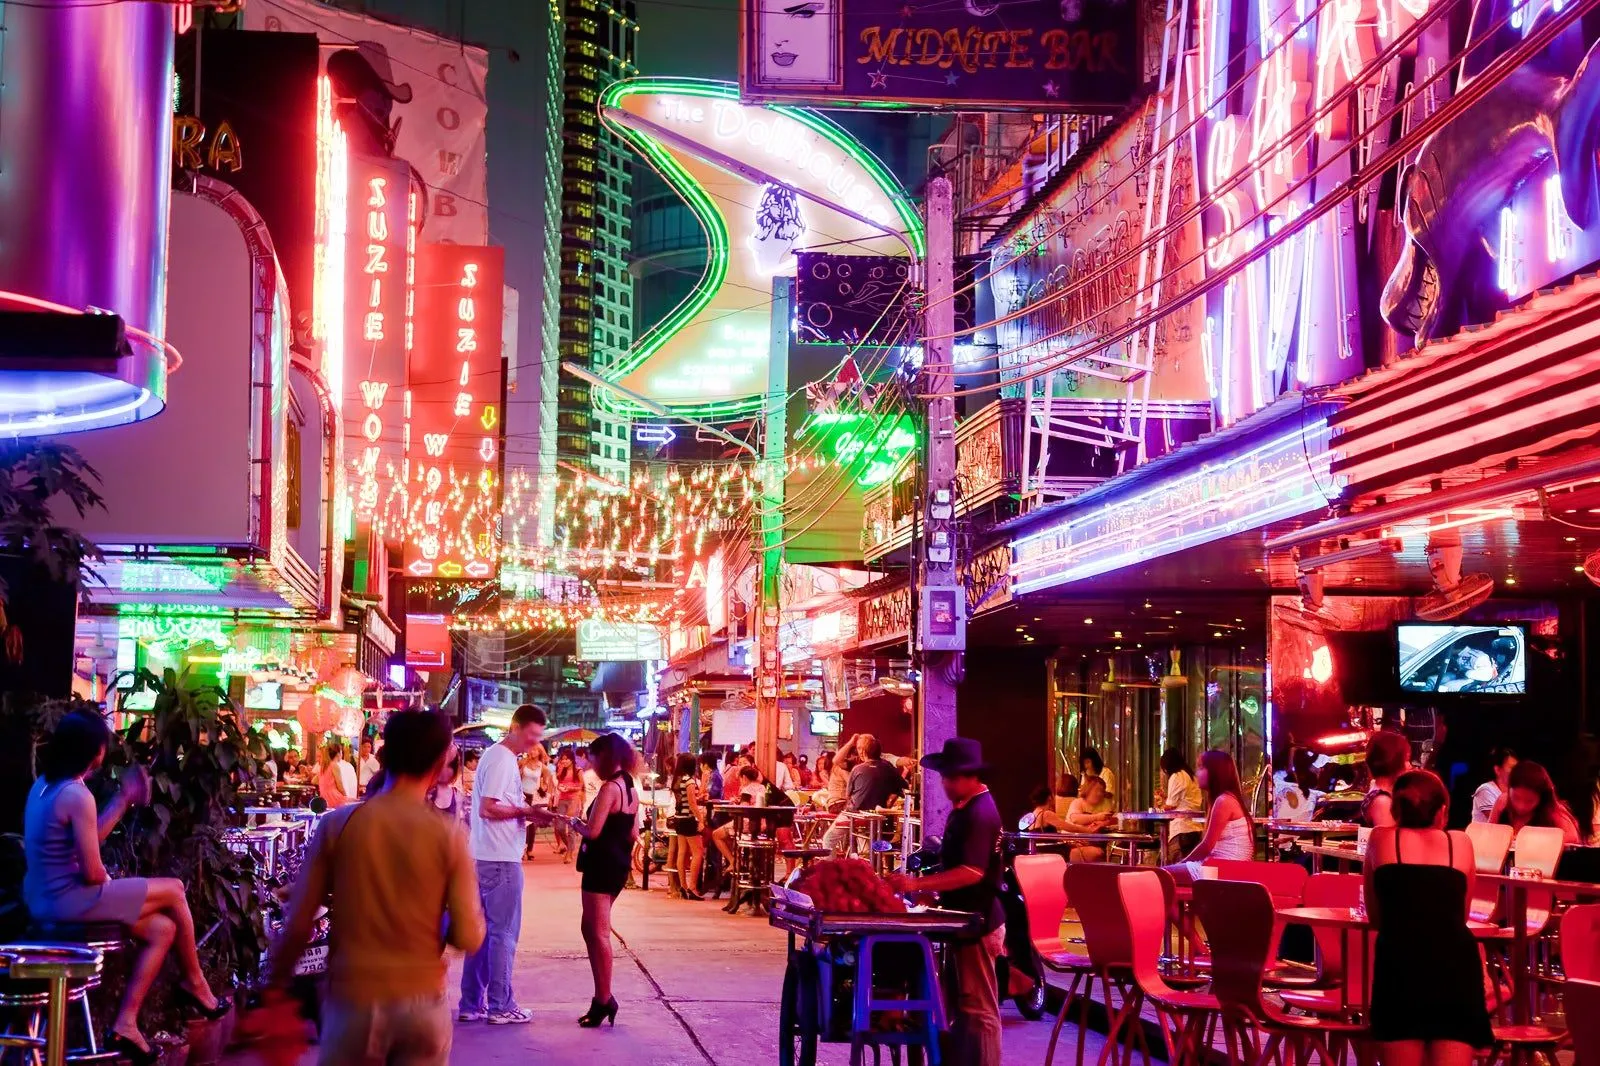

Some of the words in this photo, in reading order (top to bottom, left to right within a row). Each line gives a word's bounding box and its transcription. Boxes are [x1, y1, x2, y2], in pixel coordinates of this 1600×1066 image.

[658, 99, 705, 124] The
[857, 24, 1034, 74] MIDNITE
[1041, 28, 1128, 73] BAR
[433, 62, 463, 246] COWB
[363, 177, 389, 342] SUZIE
[454, 262, 478, 417] SUZIE
